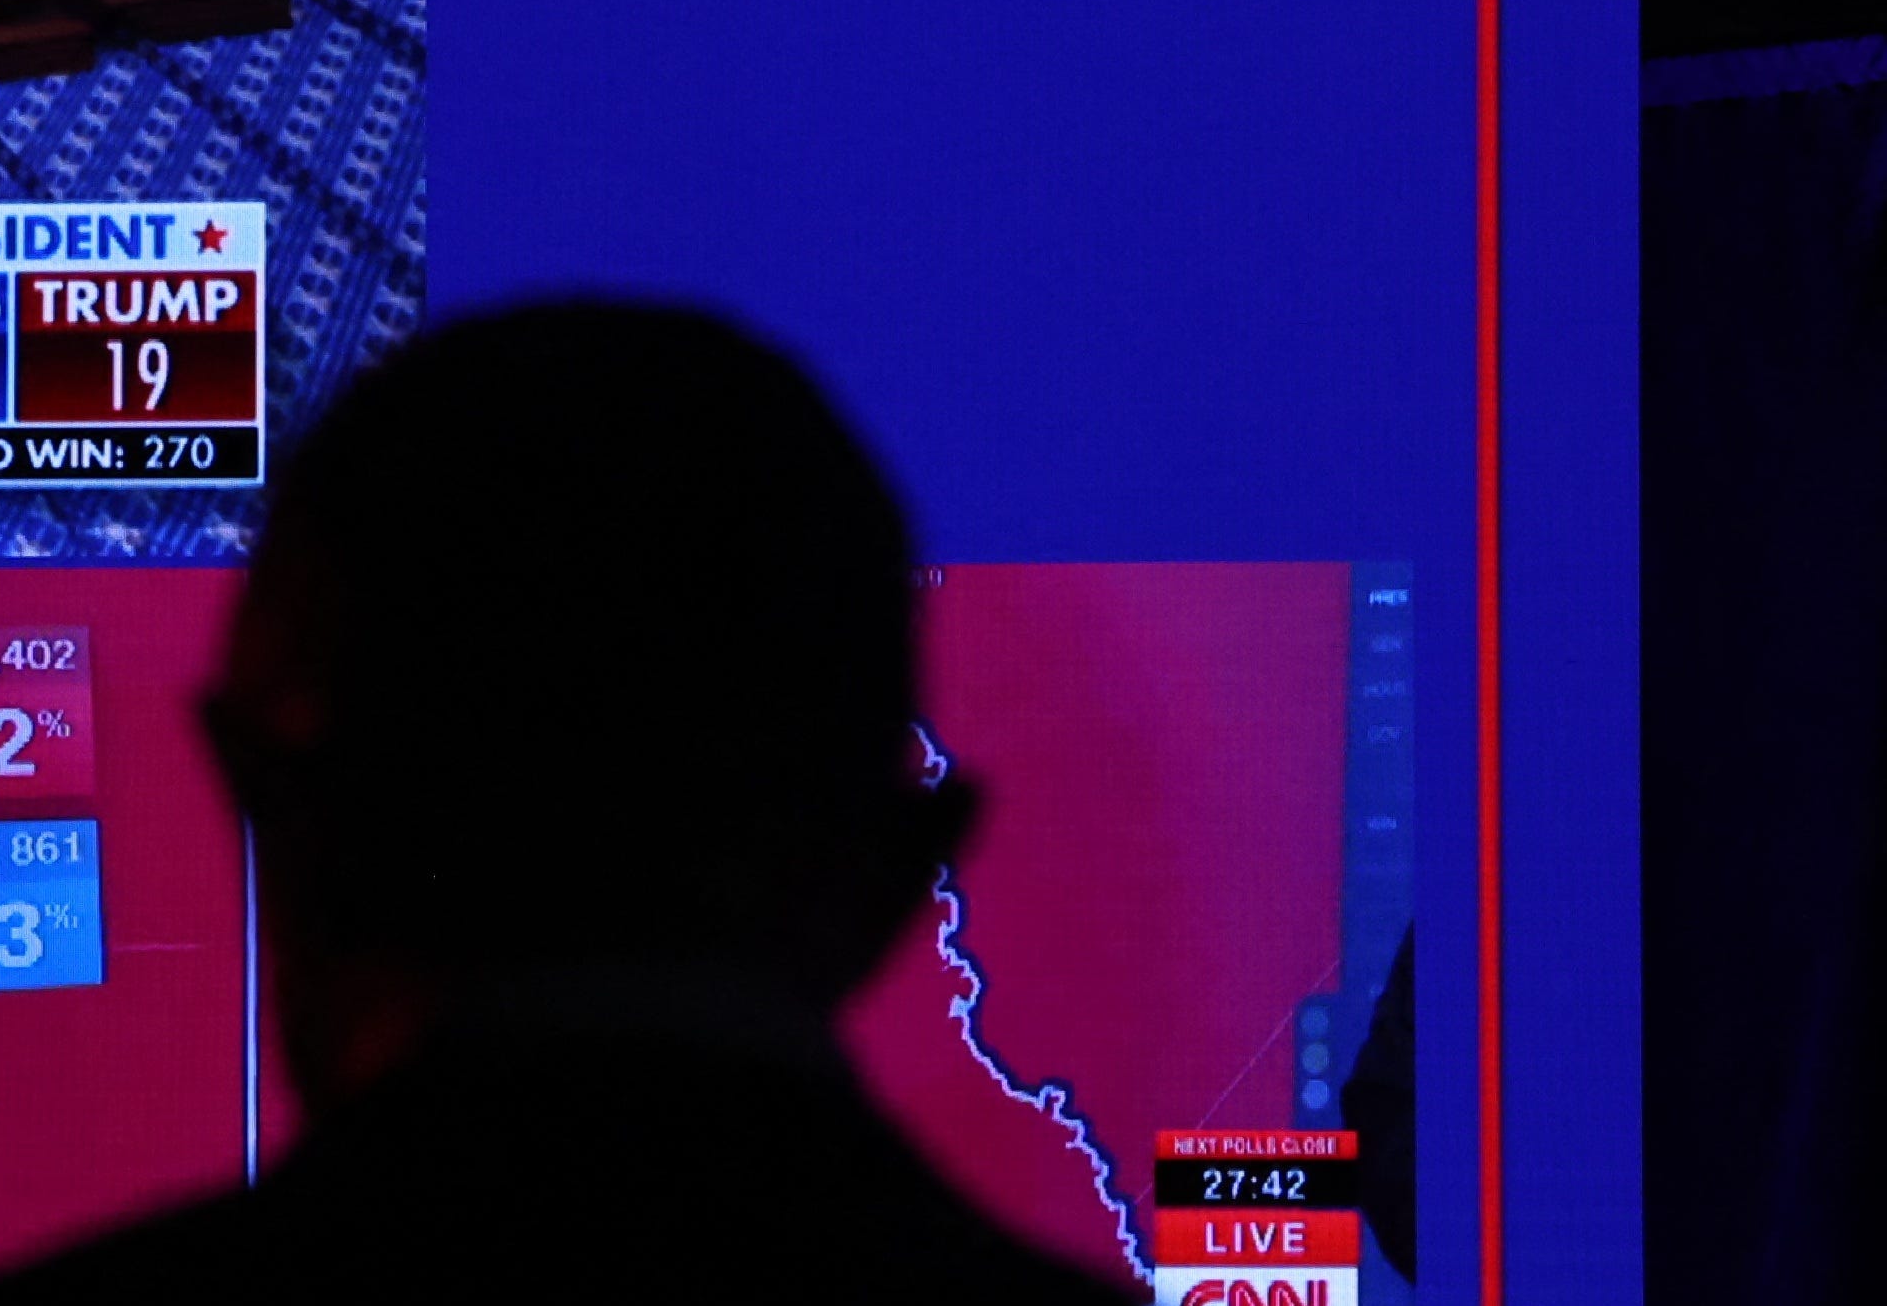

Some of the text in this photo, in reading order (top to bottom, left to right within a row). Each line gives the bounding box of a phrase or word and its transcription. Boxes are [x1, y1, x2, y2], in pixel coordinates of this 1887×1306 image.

[34, 280, 240, 323] TRUMP
[105, 338, 168, 410] 19
[27, 437, 125, 470] WIN:
[143, 436, 214, 468] 270
[11, 833, 80, 865] 861
[1175, 1136, 1336, 1154] NEXT POLLS CLOSE
[1203, 1168, 1305, 1199] 27:42
[1205, 1222, 1305, 1253] LIVE
